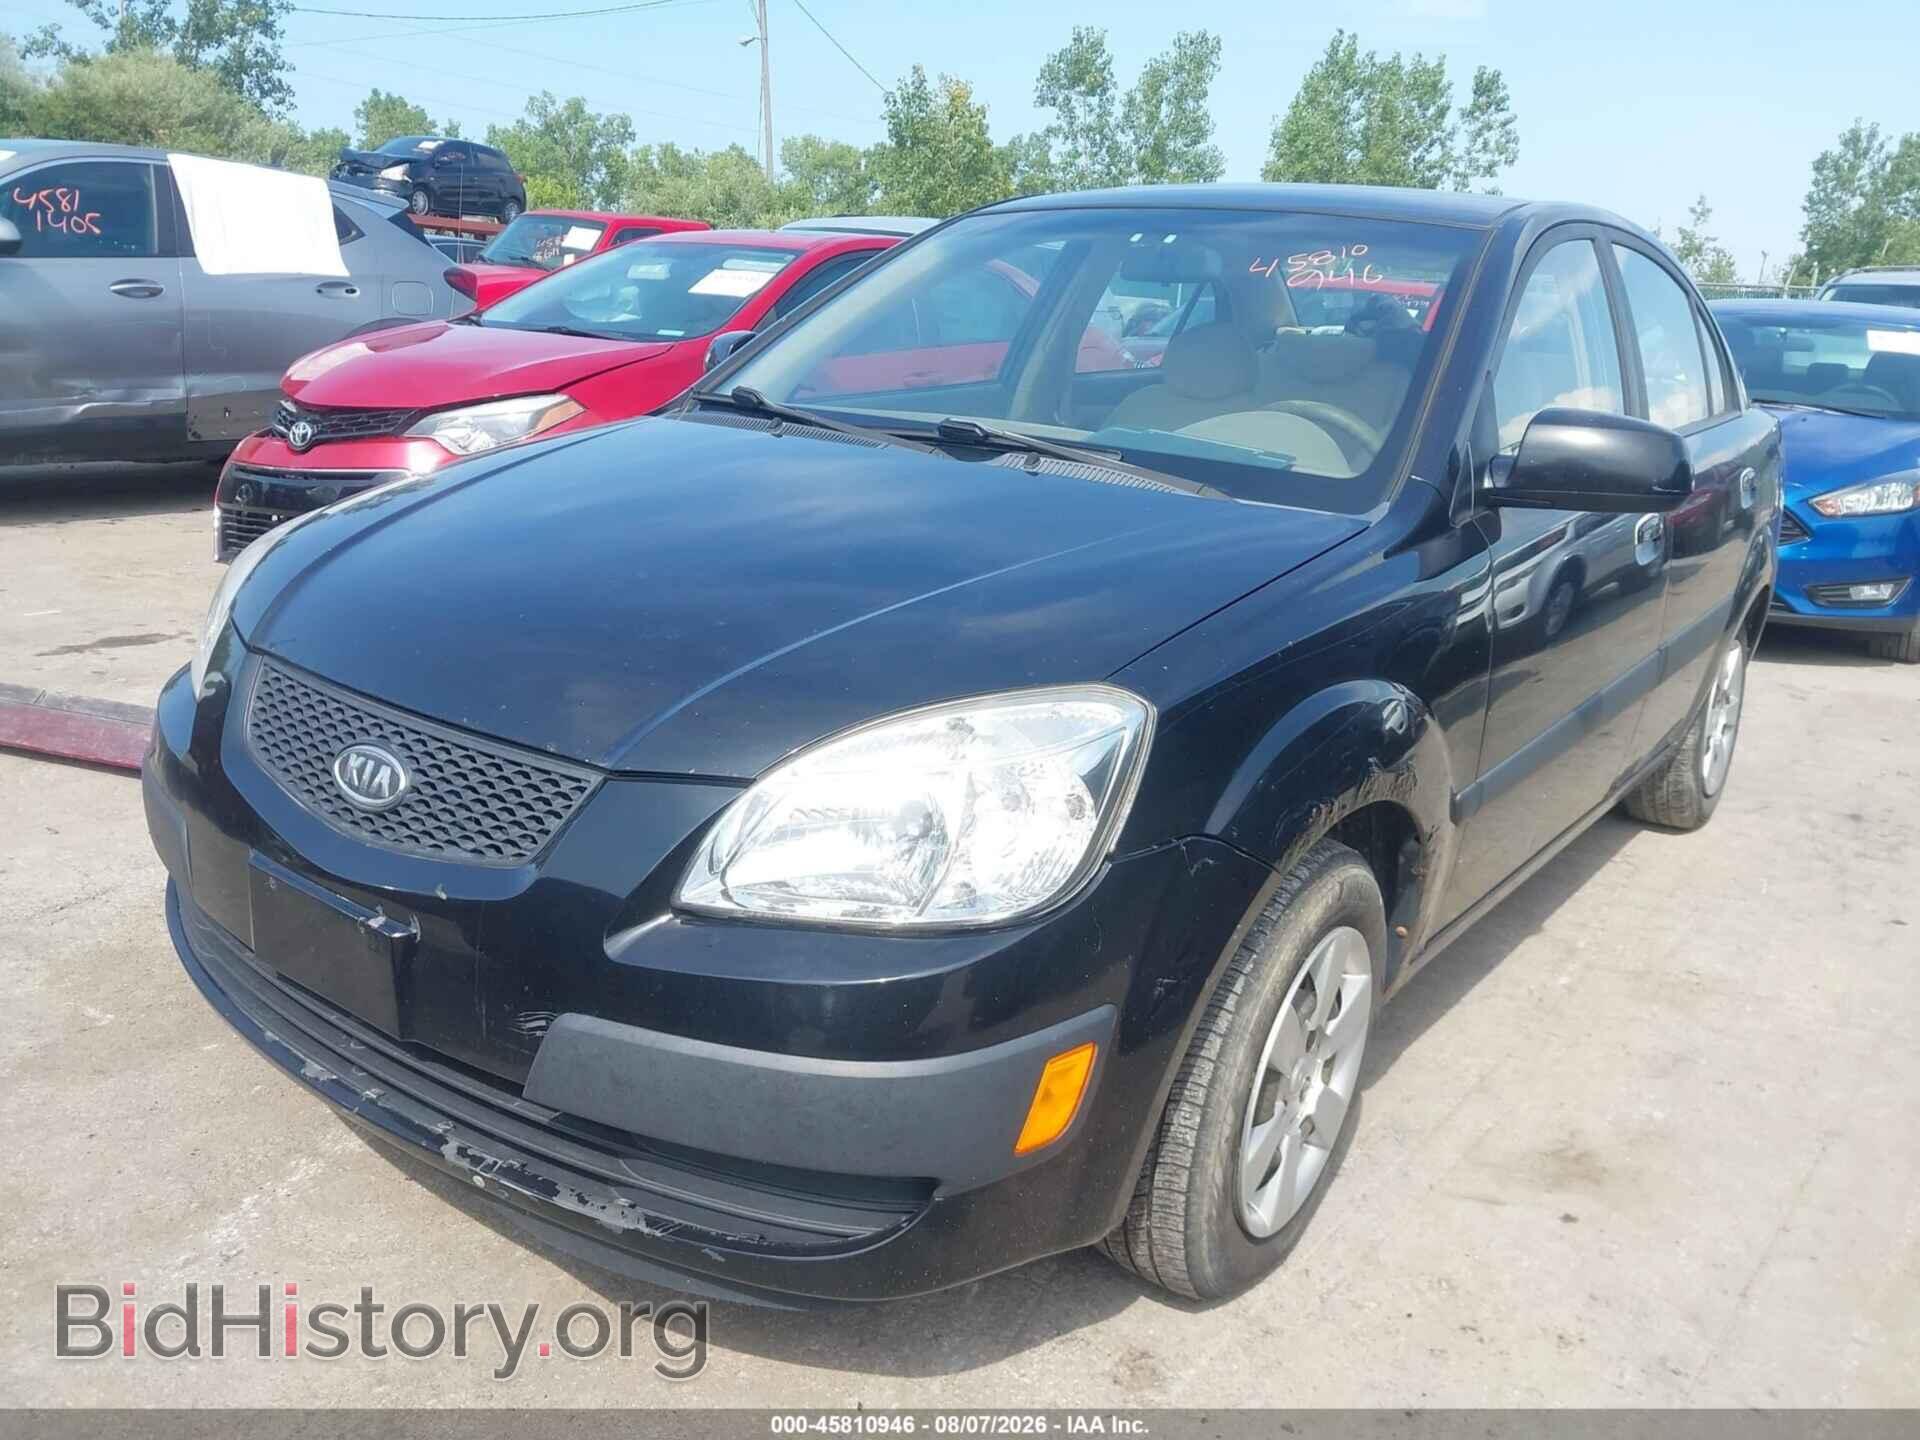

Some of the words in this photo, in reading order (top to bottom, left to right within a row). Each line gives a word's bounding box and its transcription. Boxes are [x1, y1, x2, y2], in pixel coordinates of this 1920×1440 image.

[13, 187, 79, 213] 4581
[36, 209, 101, 234] 1405
[344, 752, 392, 798] KIA
